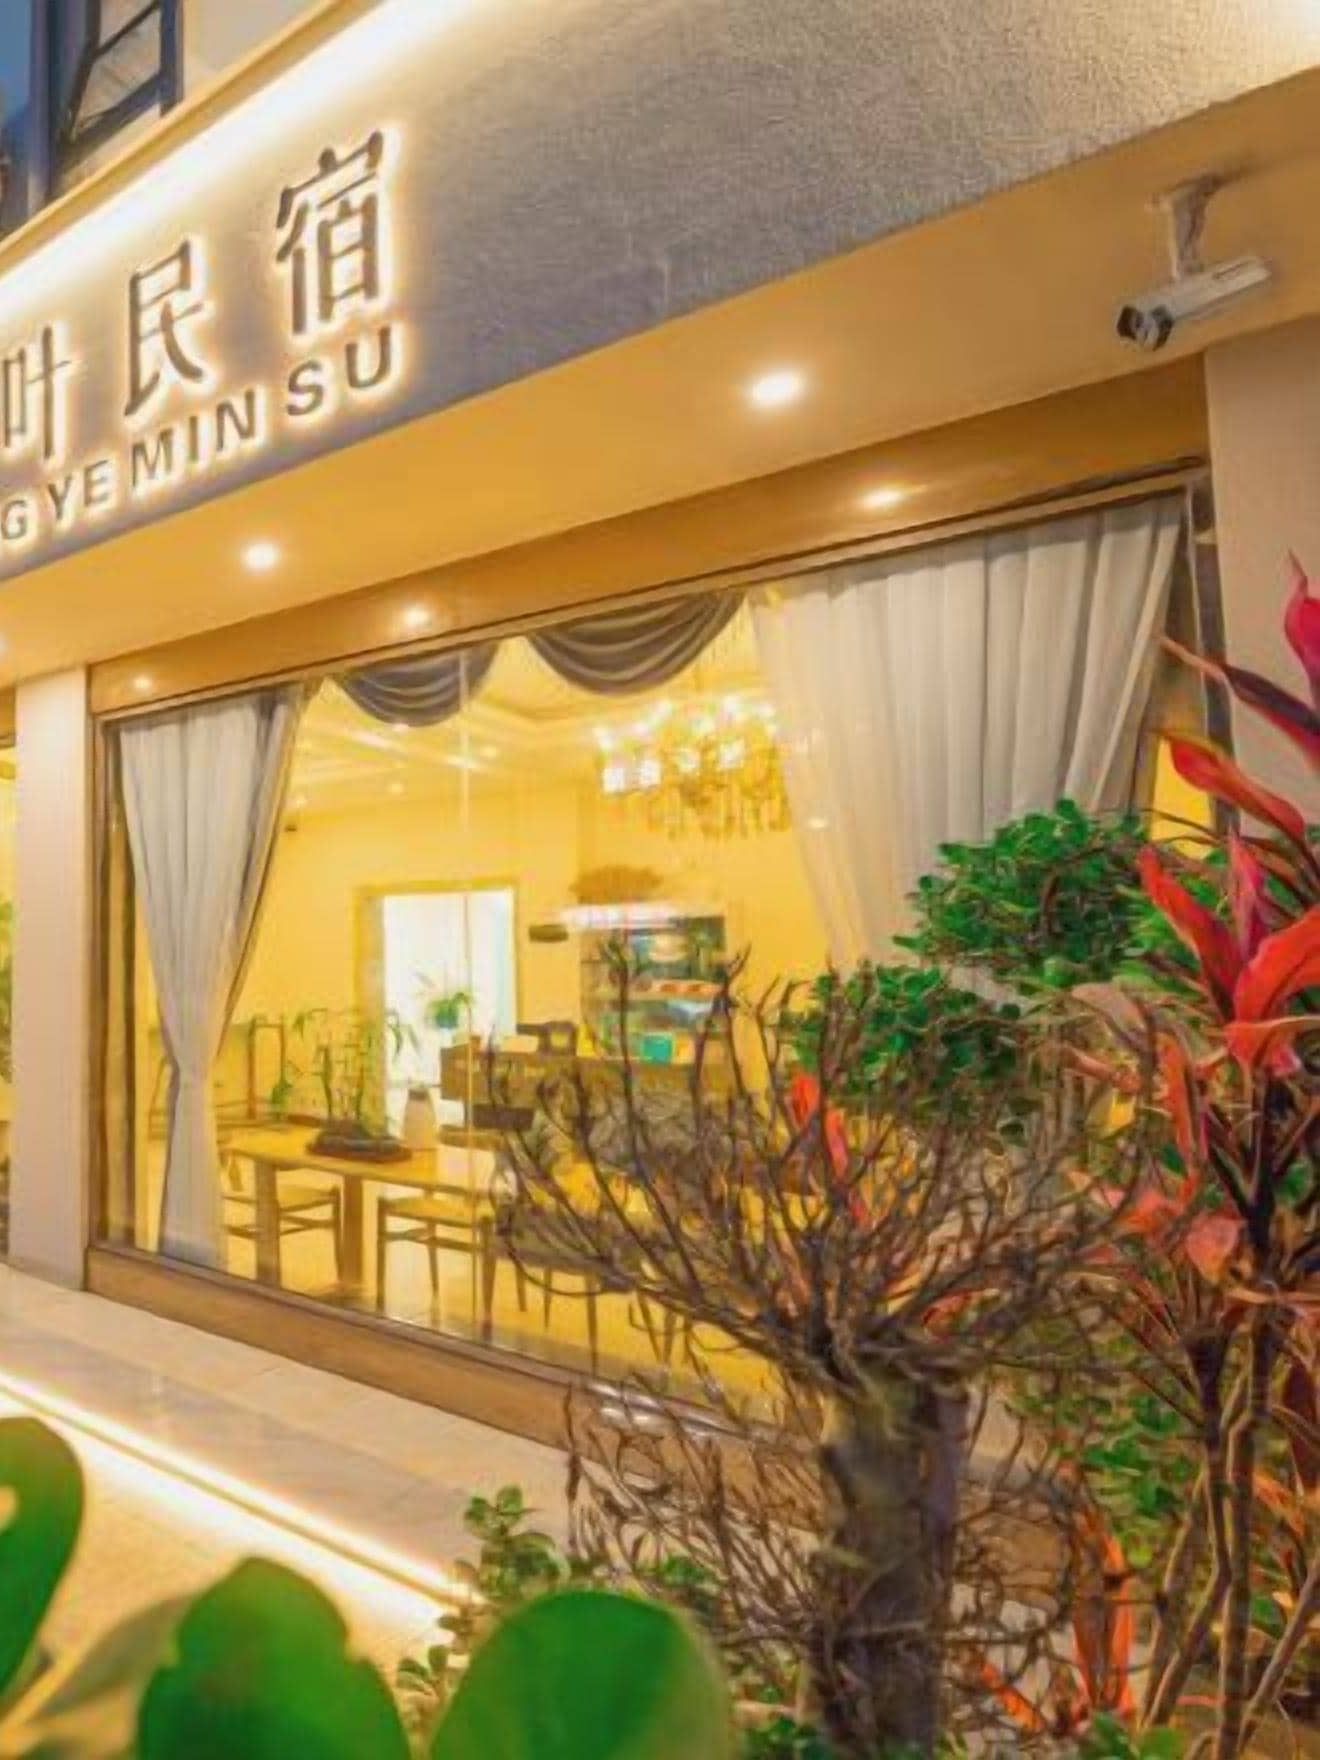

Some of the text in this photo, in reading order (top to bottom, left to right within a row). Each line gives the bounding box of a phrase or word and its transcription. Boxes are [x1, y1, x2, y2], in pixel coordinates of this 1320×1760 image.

[48, 459, 110, 520] YE
[131, 389, 257, 489] MIN
[286, 326, 392, 416] SU
